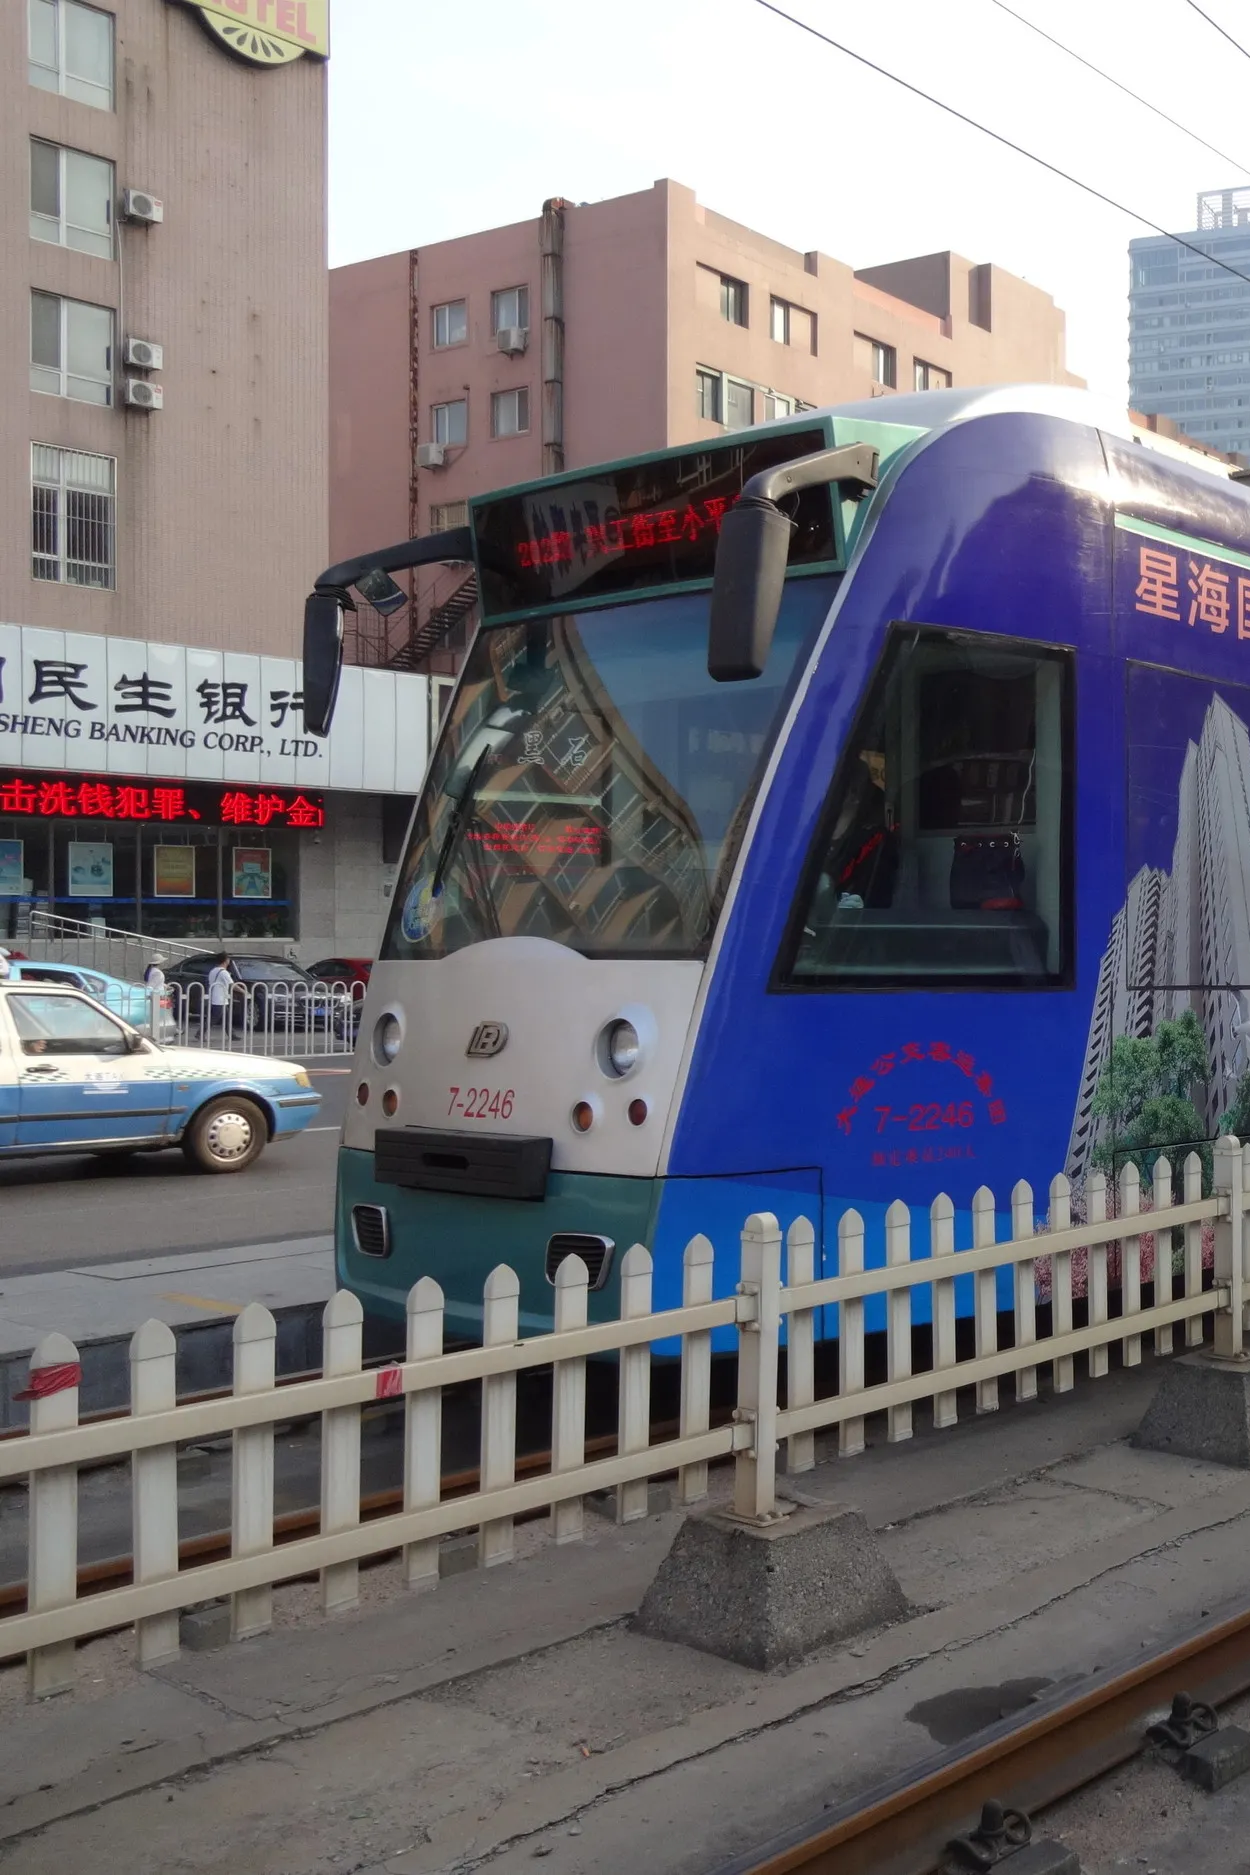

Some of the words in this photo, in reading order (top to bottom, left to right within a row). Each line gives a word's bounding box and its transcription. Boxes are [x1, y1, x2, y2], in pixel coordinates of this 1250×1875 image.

[583, 494, 742, 558] 兴工街至小平
[89, 721, 196, 749] BANKING
[203, 731, 272, 758] CORP.,
[279, 738, 323, 758] LTD.
[447, 1087, 515, 1120] 7-2246
[875, 1101, 974, 1133] 7-2246
